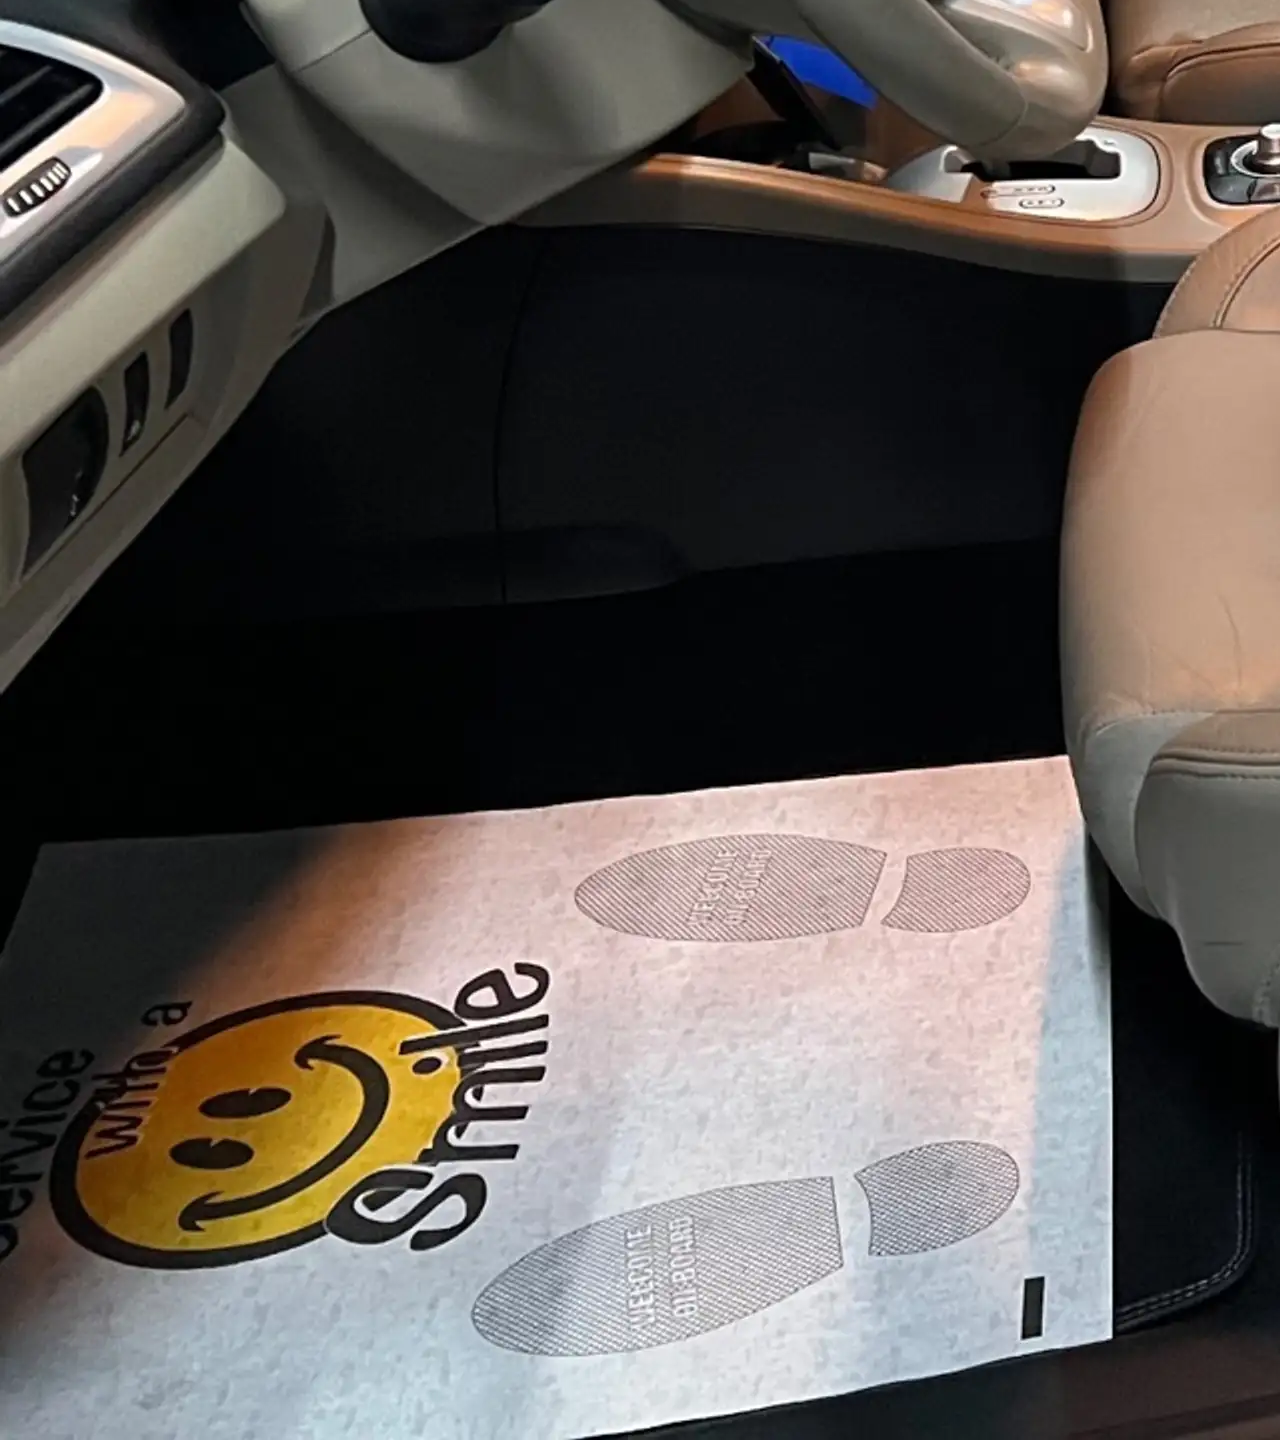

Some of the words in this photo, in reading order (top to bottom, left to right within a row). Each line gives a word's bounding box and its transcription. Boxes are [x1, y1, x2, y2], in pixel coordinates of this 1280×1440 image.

[686, 849, 739, 927] WELCOME
[722, 902, 750, 925] ON
[733, 850, 772, 901] BOARD
[84, 1048, 180, 1161] with
[140, 1000, 193, 1027] a
[326, 961, 551, 1252] Smile
[0, 1048, 95, 1260] ervice
[628, 1222, 657, 1330] WELCOME
[668, 1216, 697, 1284] BOARD
[672, 1288, 699, 1318] ON
